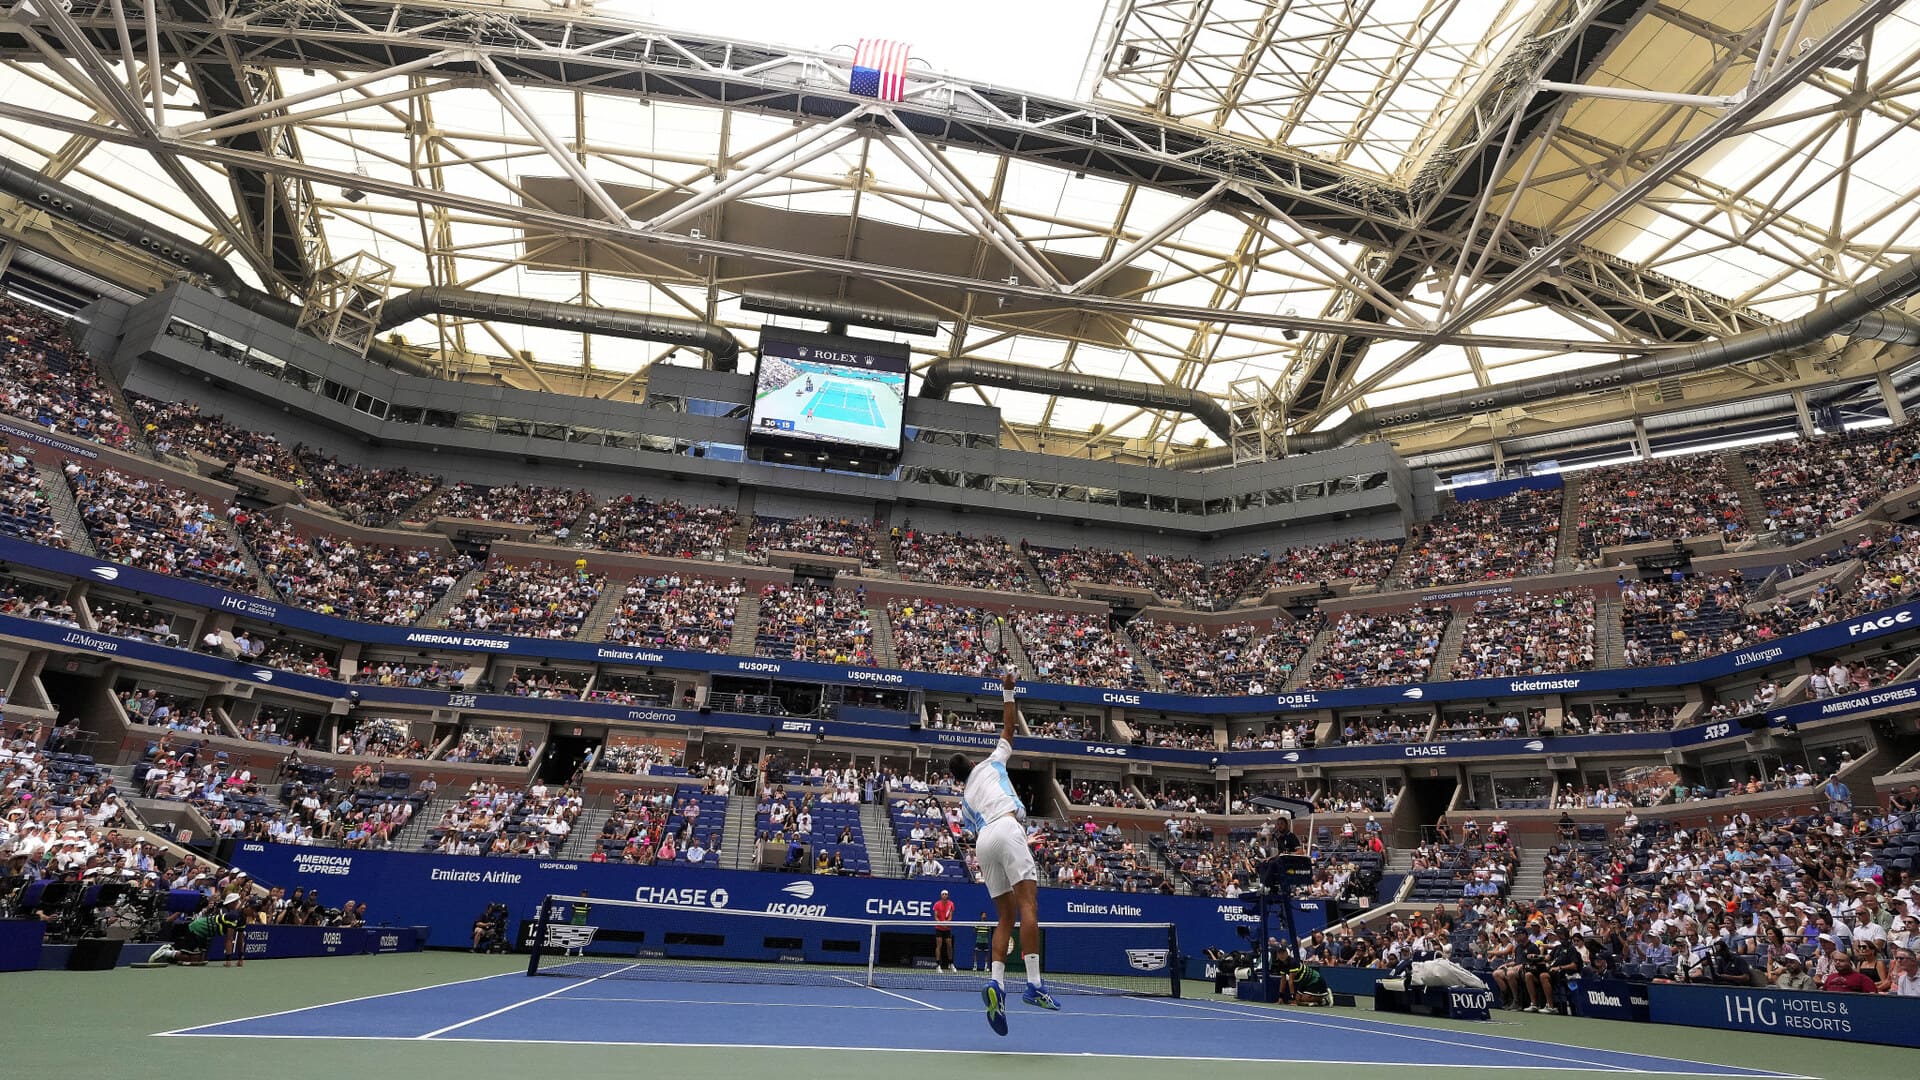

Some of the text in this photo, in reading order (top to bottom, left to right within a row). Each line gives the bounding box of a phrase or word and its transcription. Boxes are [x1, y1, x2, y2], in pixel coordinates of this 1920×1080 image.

[814, 350, 858, 363] ROLEX
[765, 418, 776, 427] 30
[35, 433, 51, 445] TEXT
[221, 595, 247, 610] IHG
[249, 602, 272, 612] HOTELS
[62, 632, 118, 652] J.P.Morgan
[407, 633, 510, 649] AMERICAN EXPRESS
[597, 648, 664, 662] Emirates Airline
[1735, 647, 1783, 667] J.P.Morgan
[738, 661, 781, 673] #USOPEN
[848, 671, 903, 683] USOPEN.ORG
[981, 681, 1027, 694] J.P.Man
[1510, 678, 1581, 692] ticketmaster
[447, 694, 477, 708] IBM
[1103, 693, 1141, 705] CHASE
[1277, 694, 1319, 705] DOBEL
[1821, 687, 1918, 715] AMERICAN EXPRESS
[628, 710, 677, 722] moderna
[782, 721, 812, 732] ESPN
[1704, 723, 1730, 740] ATP
[938, 734, 1000, 746] POLO RALPH LAURE
[1404, 746, 1448, 757] CHASE
[243, 843, 265, 853] USTA
[293, 854, 352, 866] AMERICAN
[539, 862, 578, 871] USOPEN.ORG
[298, 863, 350, 876] EXPRESS
[431, 868, 522, 884] Emirates Airline
[635, 886, 708, 906] CHASE
[533, 904, 565, 921] IM
[766, 902, 827, 920] us open
[865, 898, 933, 917] CHASE
[1067, 901, 1142, 917] Emirates Airline
[1217, 905, 1244, 914] AMER
[1300, 902, 1319, 910] USTA
[1223, 913, 1262, 922] EXPRES
[322, 932, 342, 945] DOBEL
[1451, 993, 1487, 1010] POLO
[1587, 990, 1622, 1007] Wilson
[1630, 996, 1648, 1006] Wilso
[1725, 995, 1778, 1026] IHG
[1782, 999, 1849, 1015] HOTELS &
[1785, 1015, 1852, 1033] RESORTS
